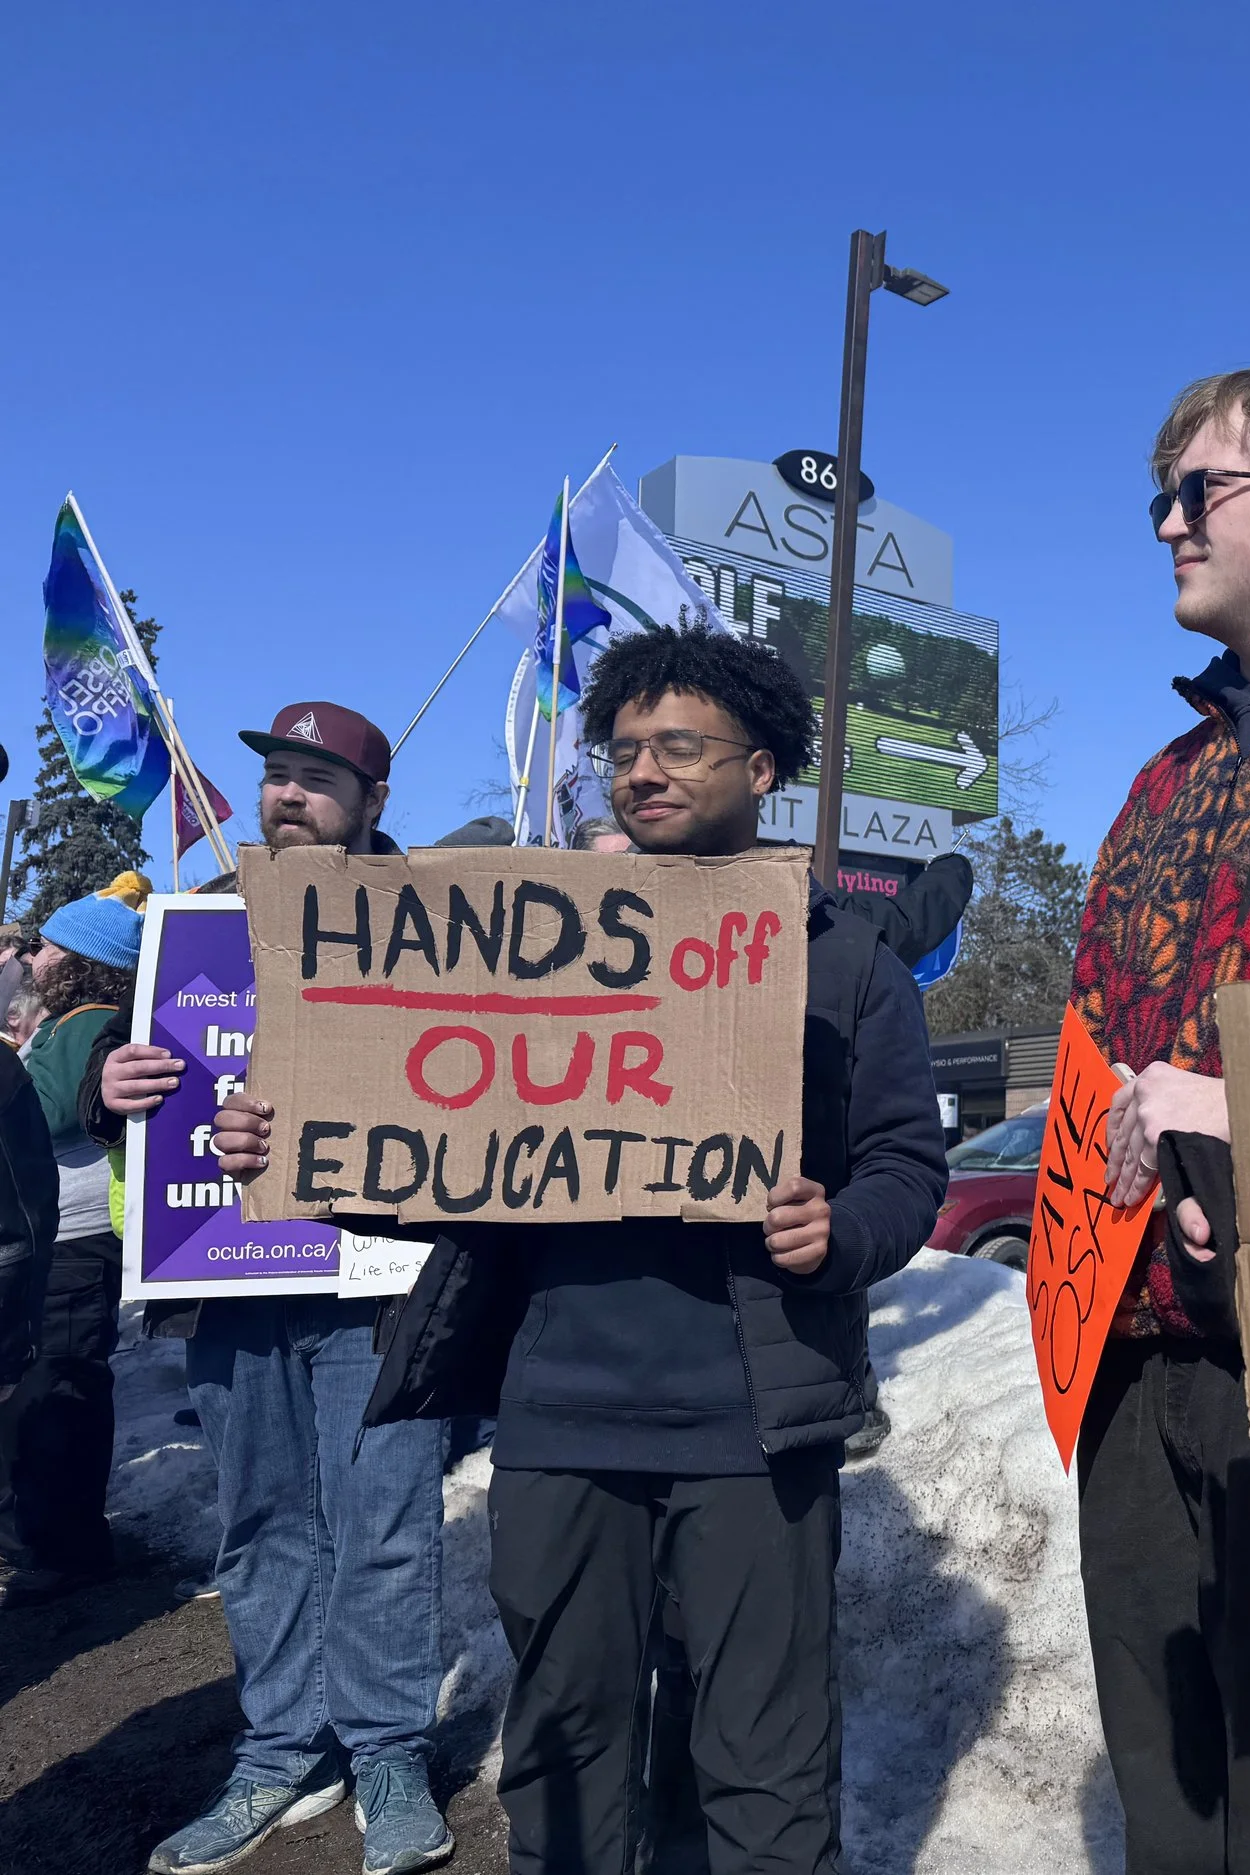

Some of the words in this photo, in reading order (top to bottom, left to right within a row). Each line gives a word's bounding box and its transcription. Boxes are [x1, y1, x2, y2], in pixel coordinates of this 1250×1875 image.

[757, 795, 803, 829] RIT
[842, 806, 938, 849] LAZA
[837, 869, 899, 897] tyling
[301, 880, 655, 989] HANDS
[670, 911, 782, 991] off
[177, 990, 238, 1008] Invest
[405, 1025, 674, 1111] OUR
[292, 1120, 785, 1214] EDUCATION
[1031, 1042, 1096, 1342] SAVE
[348, 1262, 383, 1280] Life
[389, 1261, 410, 1275] for
